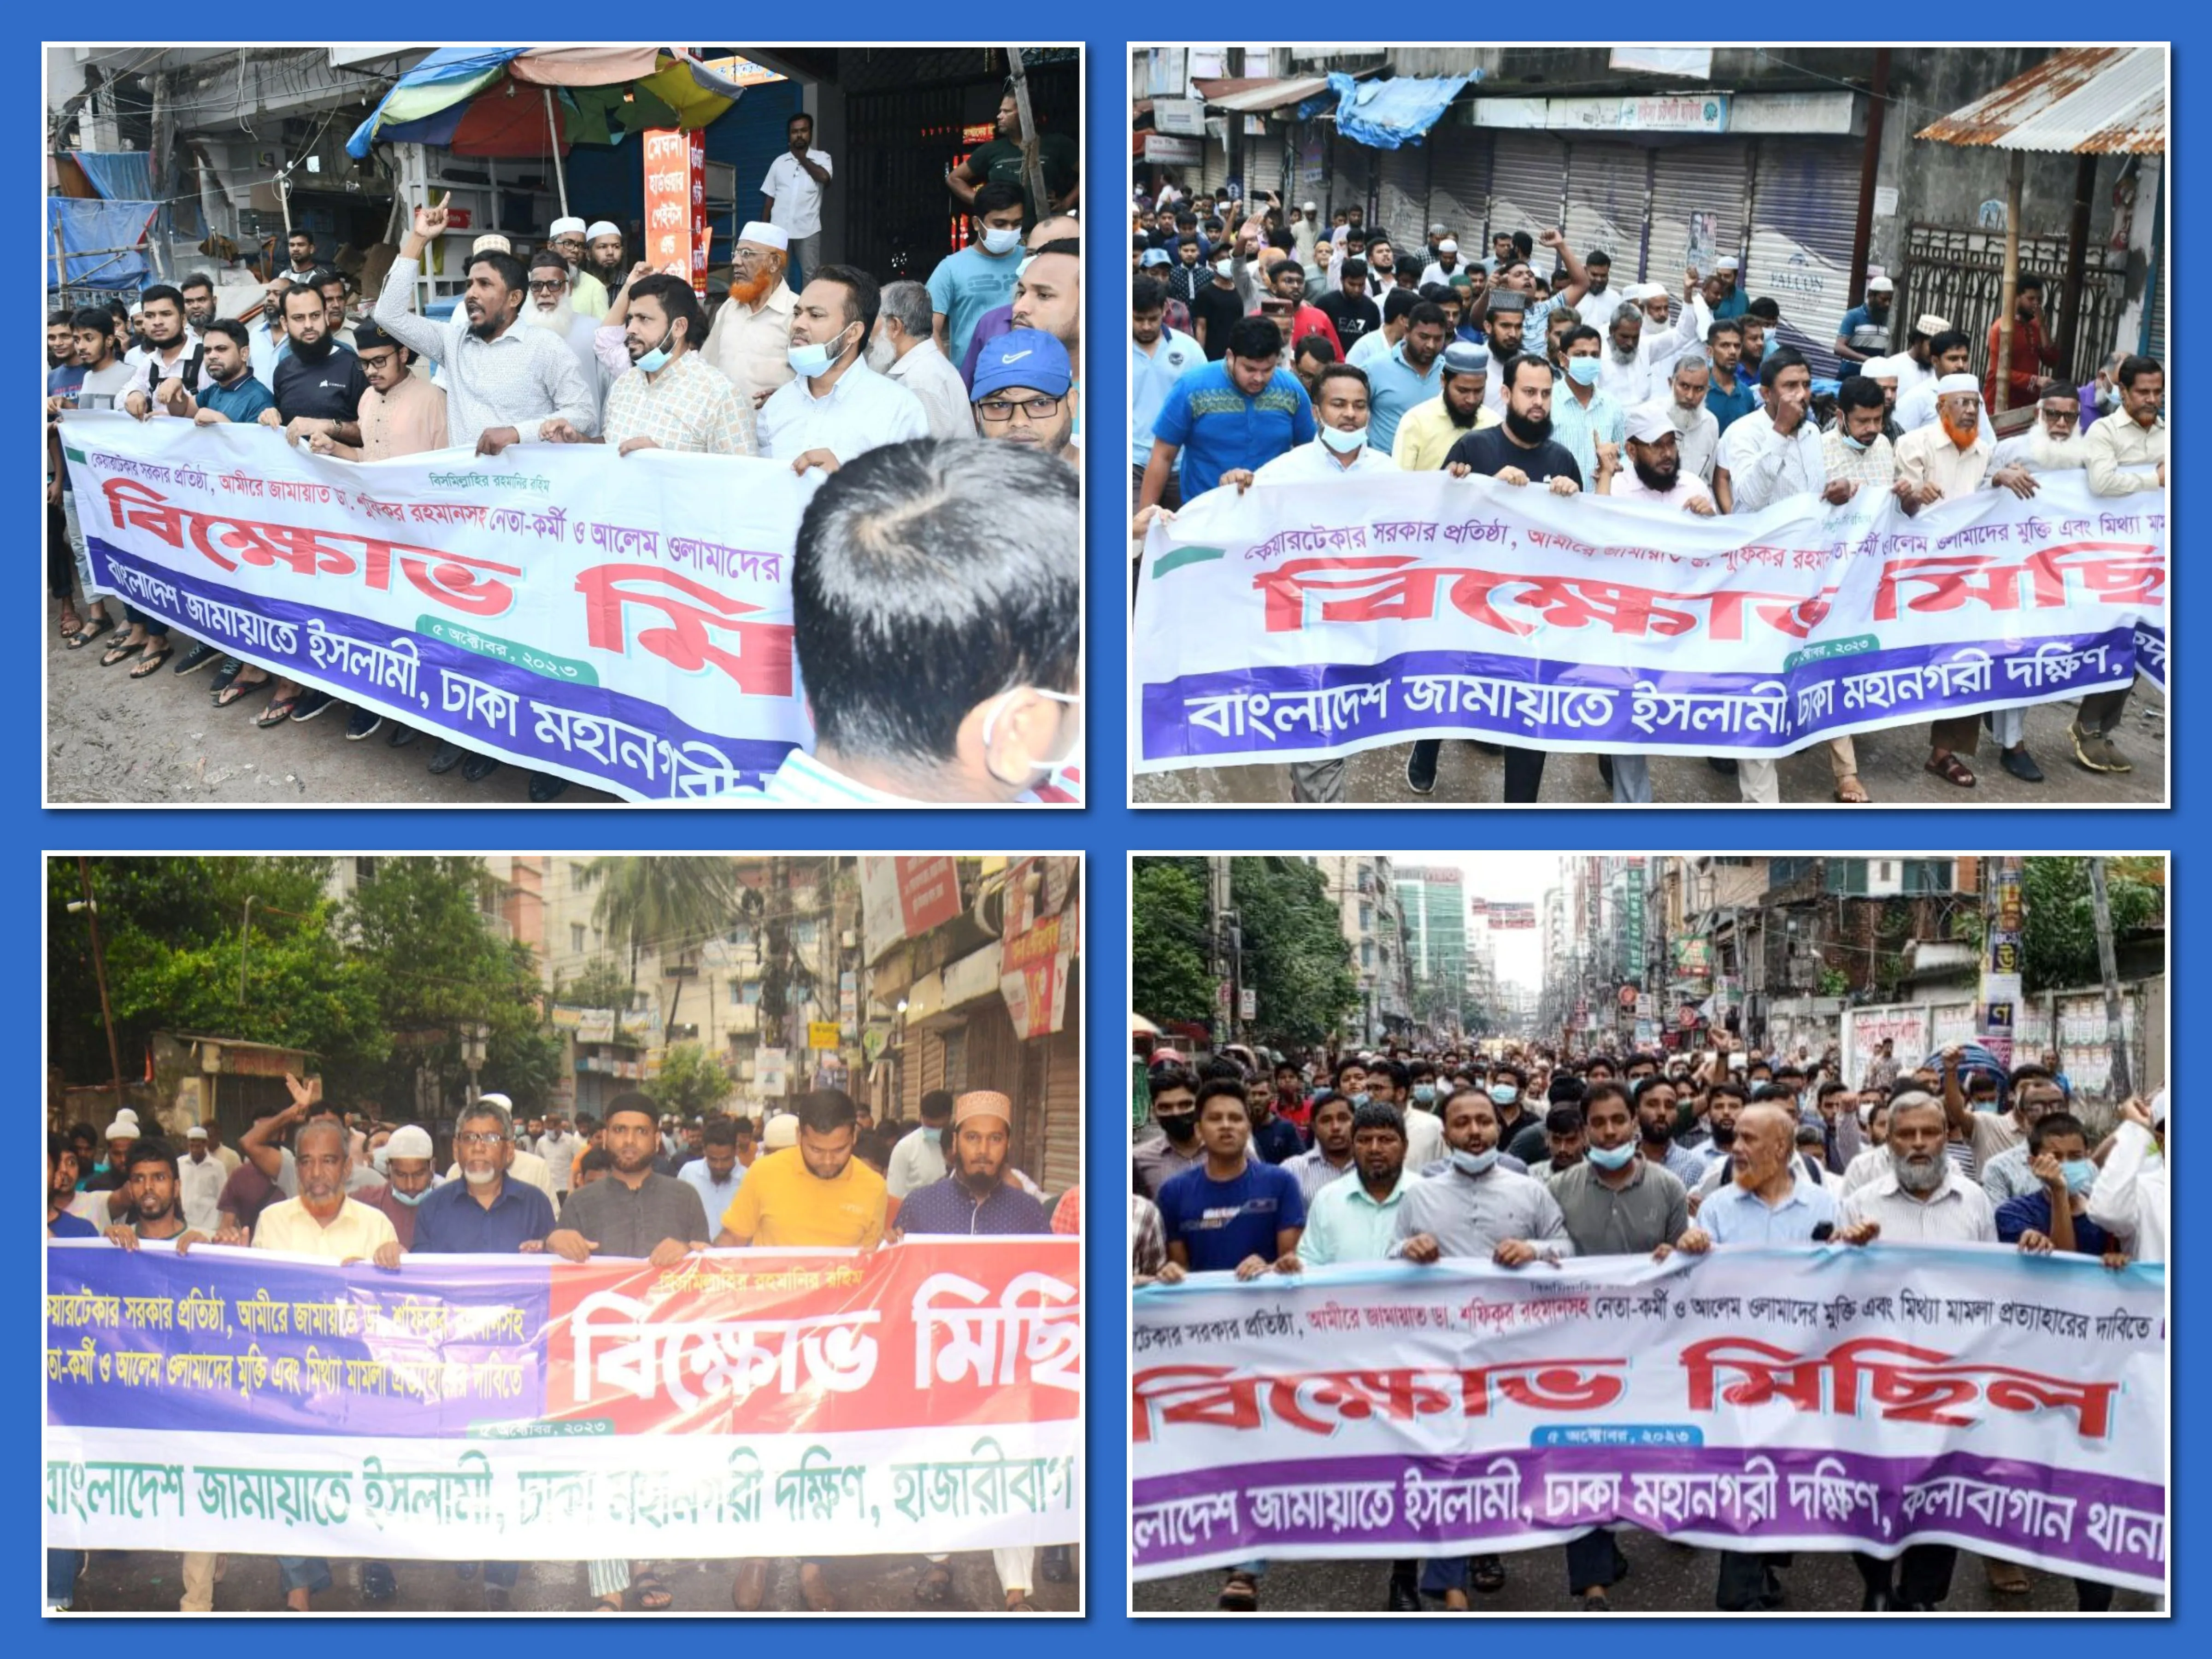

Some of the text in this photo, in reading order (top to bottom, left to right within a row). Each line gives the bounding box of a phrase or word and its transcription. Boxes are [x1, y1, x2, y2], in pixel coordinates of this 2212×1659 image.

[647, 135, 683, 159] মেঘনা
[1338, 317, 1365, 331] EA7
[429, 472, 550, 492] বিসমিল্লাহির রহমানির রহিম
[92, 453, 138, 476] কেয়ারটেকার
[139, 462, 170, 483] সরকার
[218, 469, 264, 497] আমীরে
[267, 479, 331, 504] জামায়াত
[408, 503, 490, 530] রহমানসহ
[490, 506, 567, 542] নেতা-কর্মী
[573, 521, 585, 544] ও
[590, 522, 659, 560] আলেম
[666, 536, 783, 583] ওলামাদের
[1244, 523, 1366, 561] কেয়ারটেকার
[1372, 520, 1439, 544] সরকার
[2015, 516, 2052, 546] মুক্তি
[2058, 519, 2092, 539] এবং
[2100, 512, 2140, 537] মিথ্যা
[102, 477, 795, 697] বিক্ষোভ মি
[1253, 541, 2165, 640] বিক্ষোভ মিছি
[106, 553, 181, 614] বাংলাদেশ
[182, 590, 299, 655] জামায়াতে
[307, 618, 430, 710] ইসলামী,
[440, 669, 520, 736] ঢাকা
[432, 624, 444, 635] ৫
[522, 652, 578, 677] ২০২৩
[1835, 640, 1869, 653] ২০২৩
[1184, 678, 1391, 741] বাংলাদেশ
[1402, 674, 1621, 729] জামায়াতে
[1631, 680, 1791, 737] ইসলামী,
[1796, 677, 1834, 728] ঢাকা
[1842, 648, 1994, 712] মহানগরী
[2004, 641, 2123, 690] দক্ষিণ,
[753, 1266, 820, 1290] রহমানির
[825, 1265, 865, 1289] রহিম
[123, 1292, 174, 1331] সরকার
[235, 1288, 290, 1334] আমীরে
[1184, 1318, 1241, 1344] সরকার
[1306, 1300, 1360, 1332] আমীরে
[1364, 1304, 1427, 1330] জামায়াত
[1519, 1294, 1591, 1324] রহমানসহ
[1594, 1288, 1668, 1322] নেতা-কর্মী
[1673, 1300, 1686, 1319] ও
[1690, 1296, 1741, 1321] আলেম
[1748, 1297, 1818, 1326] ওলামাদের
[1824, 1294, 1858, 1330] মুক্তি
[1862, 1297, 1894, 1322] এবং
[1900, 1288, 1941, 1325] মিথ্যা
[1946, 1299, 1995, 1327] মামলা
[1999, 1300, 2091, 1338] প্রত্যাহারের
[2095, 1306, 2153, 1341] দাবিতে
[47, 1336, 96, 1385] তা-কর্মী
[100, 1353, 111, 1382] ও
[115, 1348, 163, 1387] আলেম
[166, 1352, 234, 1389] ওলামাদের
[236, 1342, 268, 1400] মুক্তি
[271, 1357, 302, 1396] এবং
[305, 1344, 343, 1396] মিথ্যা
[346, 1357, 387, 1397] মামলা
[472, 1350, 524, 1400] দাবিতে
[570, 1271, 1079, 1414] বিক্ষোভ মিছি
[1132, 1337, 2120, 1443] বিক্ষোভ মিছিল
[564, 1421, 606, 1435] ২০২৩
[194, 1465, 353, 1527] জামায়াতে
[775, 1443, 882, 1529] দক্ষিণ,
[888, 1435, 1074, 1522] হাজারীবাগ
[1132, 1490, 1239, 1558] লাদেশ
[1246, 1479, 1396, 1534] জামায়াতে
[1403, 1457, 1534, 1530] ইসলামী,
[1544, 1469, 1623, 1518] ঢাকা
[1633, 1455, 1779, 1524] মহানগরী
[1787, 1457, 1893, 1537] দক্ষিণ,
[1903, 1477, 2076, 1543] কলাবাগান
